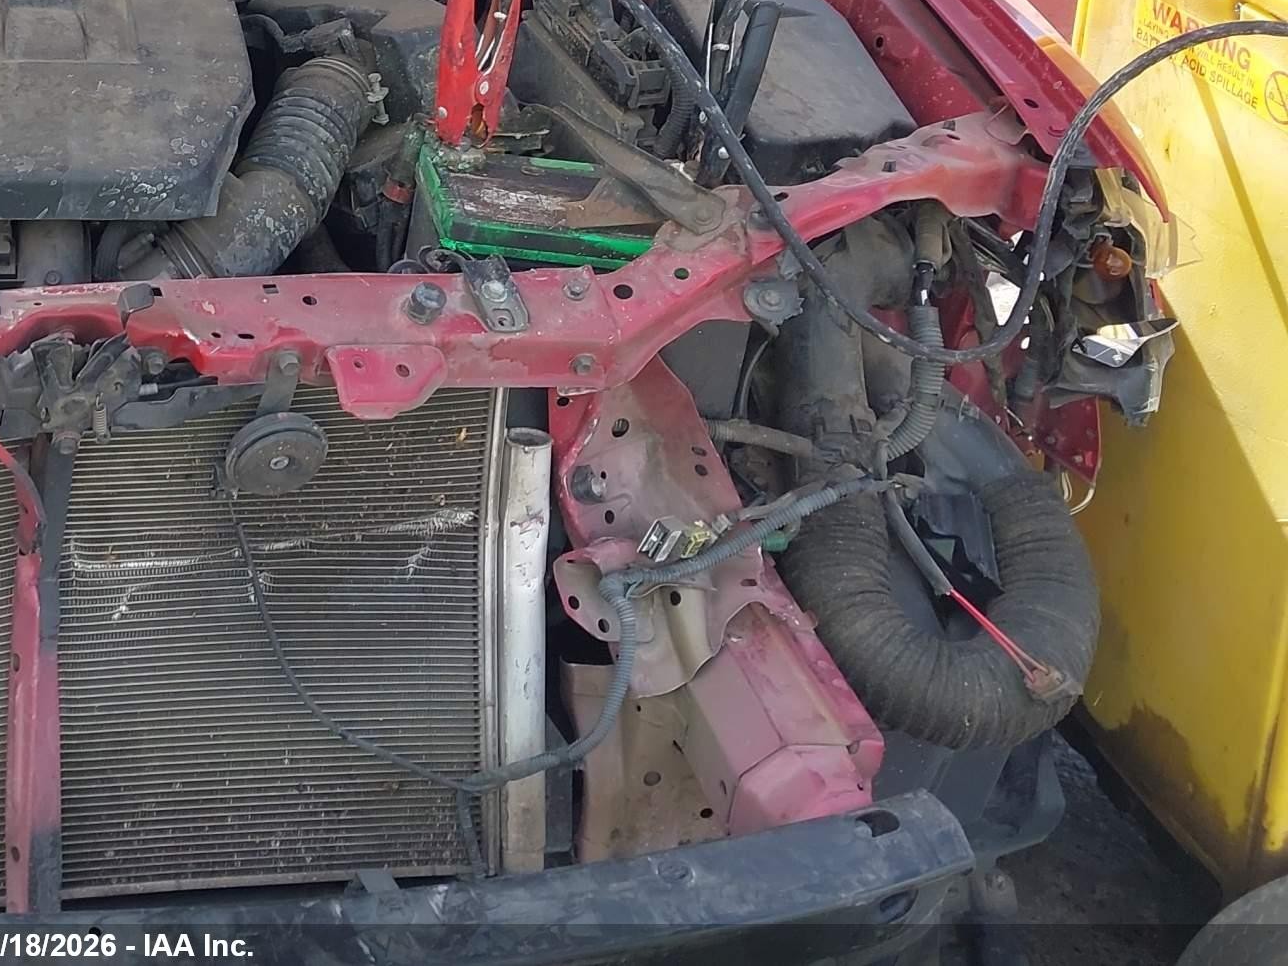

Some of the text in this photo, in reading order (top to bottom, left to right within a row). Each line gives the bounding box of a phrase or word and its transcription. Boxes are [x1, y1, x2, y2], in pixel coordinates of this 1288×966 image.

[1182, 55, 1207, 76] ACID
[1209, 70, 1258, 109] SPILLAGE
[1217, 59, 1247, 82] RESULT
